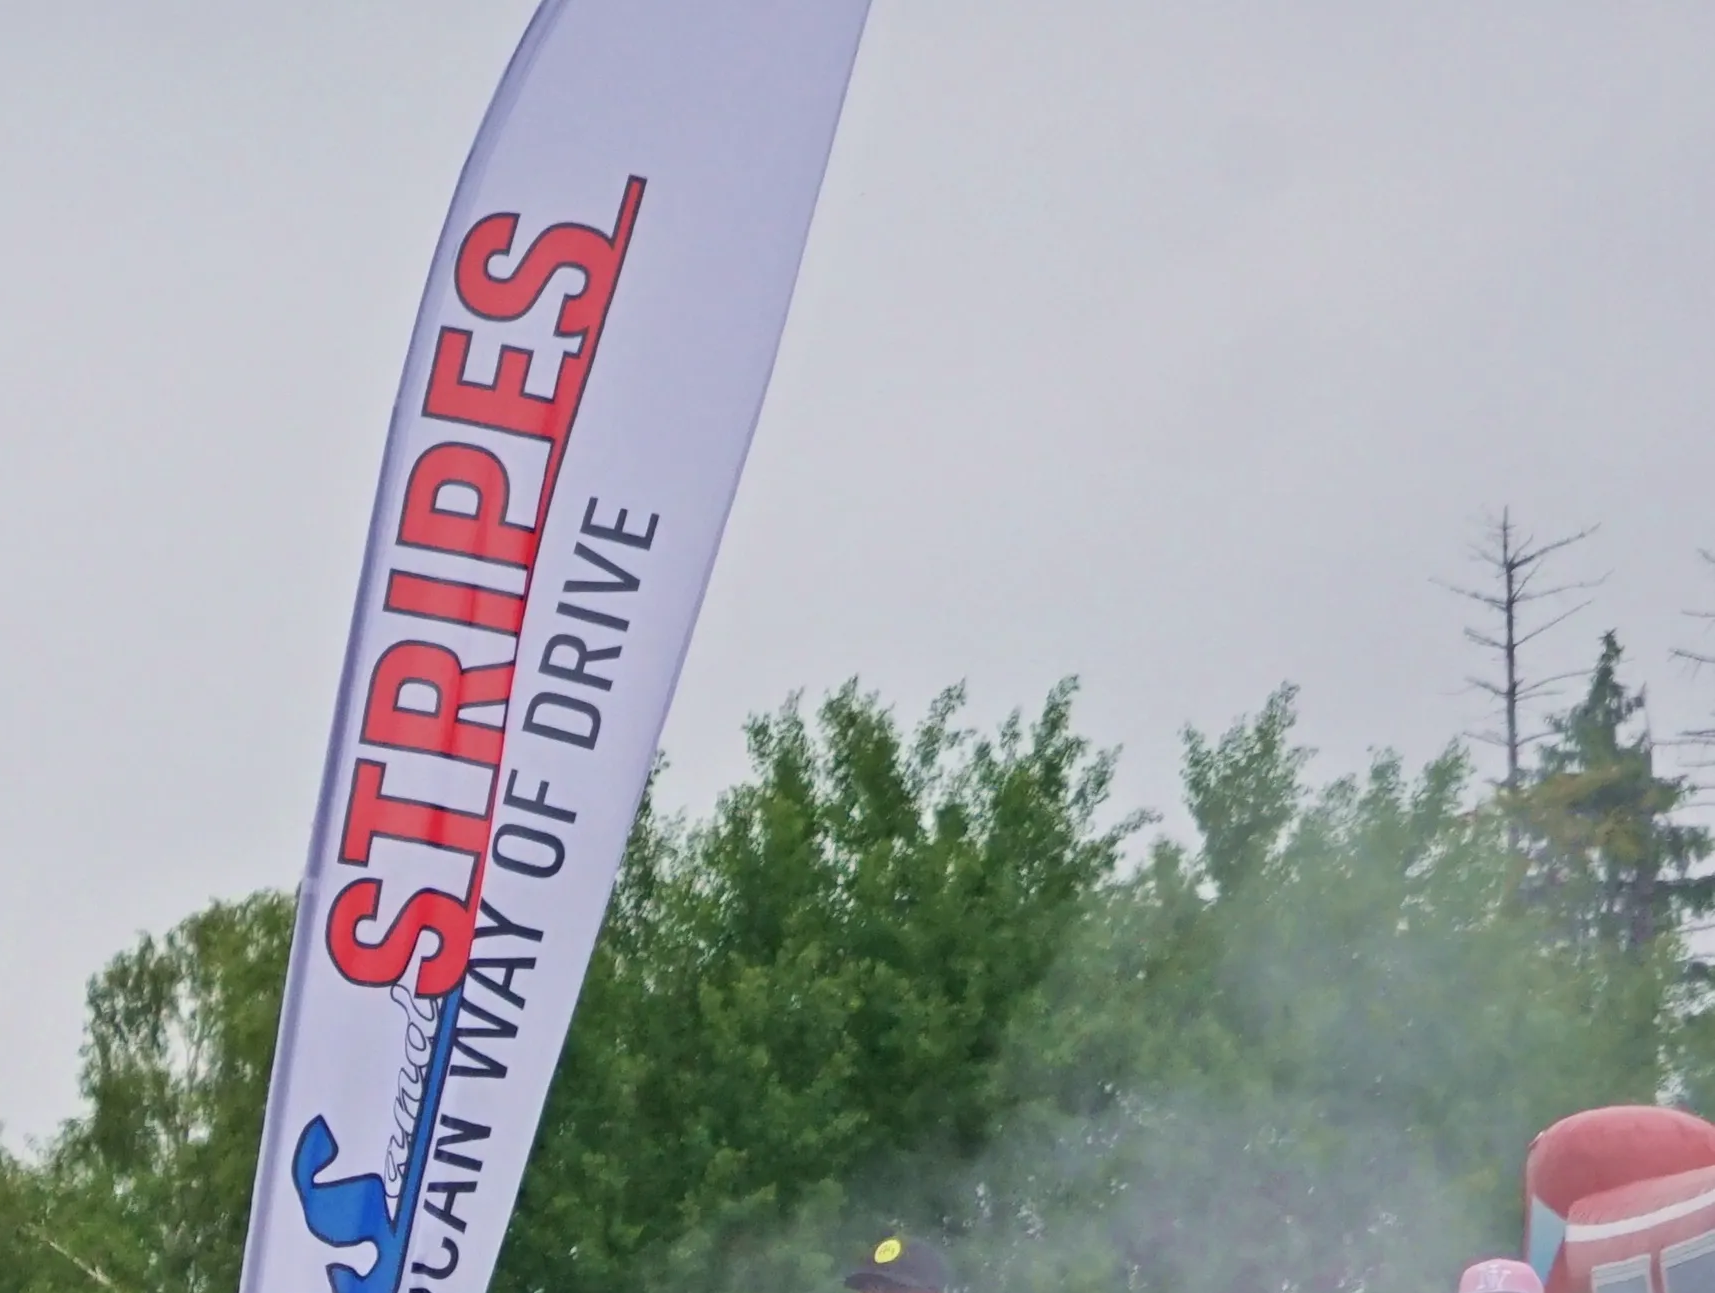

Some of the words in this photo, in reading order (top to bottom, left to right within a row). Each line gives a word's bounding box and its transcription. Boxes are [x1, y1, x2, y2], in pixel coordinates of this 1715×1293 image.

[326, 174, 647, 998] STRIPES
[522, 496, 660, 750] DRIVE
[491, 769, 577, 878] OF
[449, 896, 544, 1079] WAY
